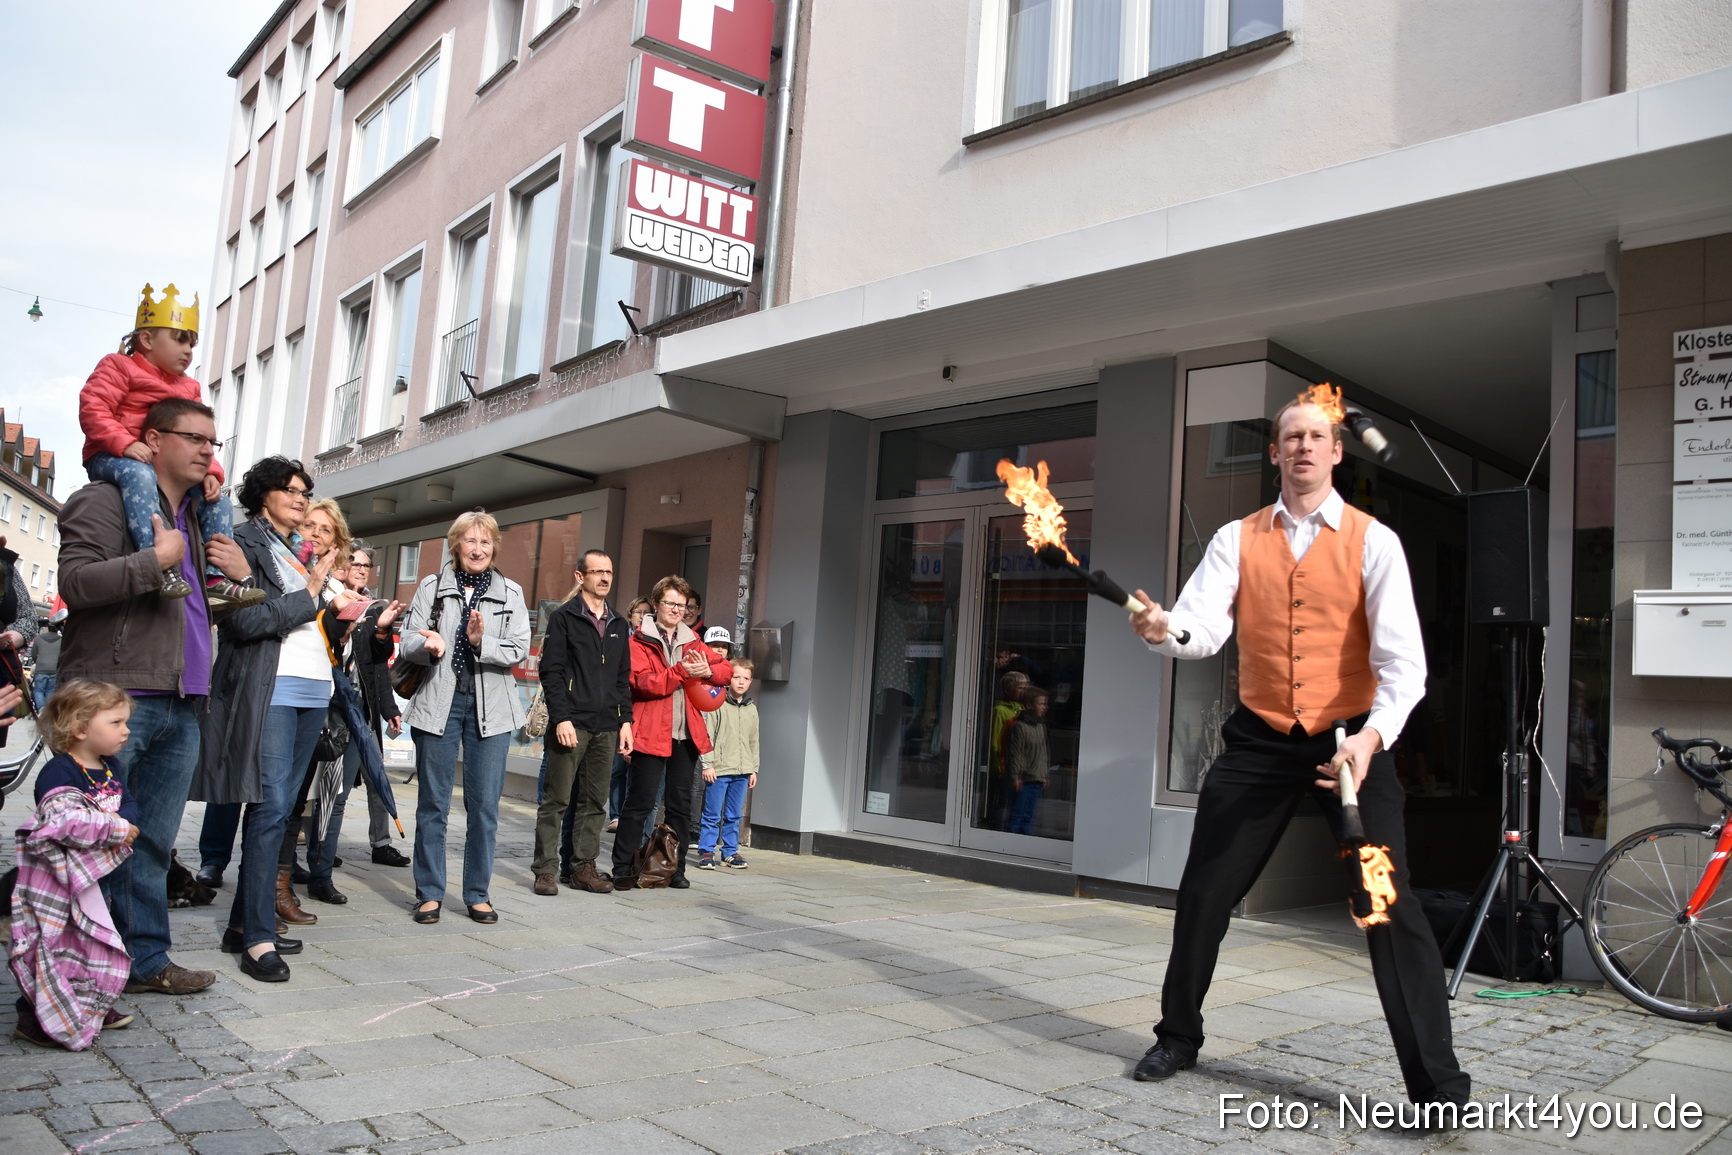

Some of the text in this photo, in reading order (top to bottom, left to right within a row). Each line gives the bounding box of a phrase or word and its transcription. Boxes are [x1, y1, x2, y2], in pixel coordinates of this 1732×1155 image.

[653, 66, 726, 152] T
[635, 164, 753, 237] WITT
[629, 213, 750, 277] WEIDEN
[1678, 331, 1732, 351] Kloste
[1695, 398, 1713, 411] G.
